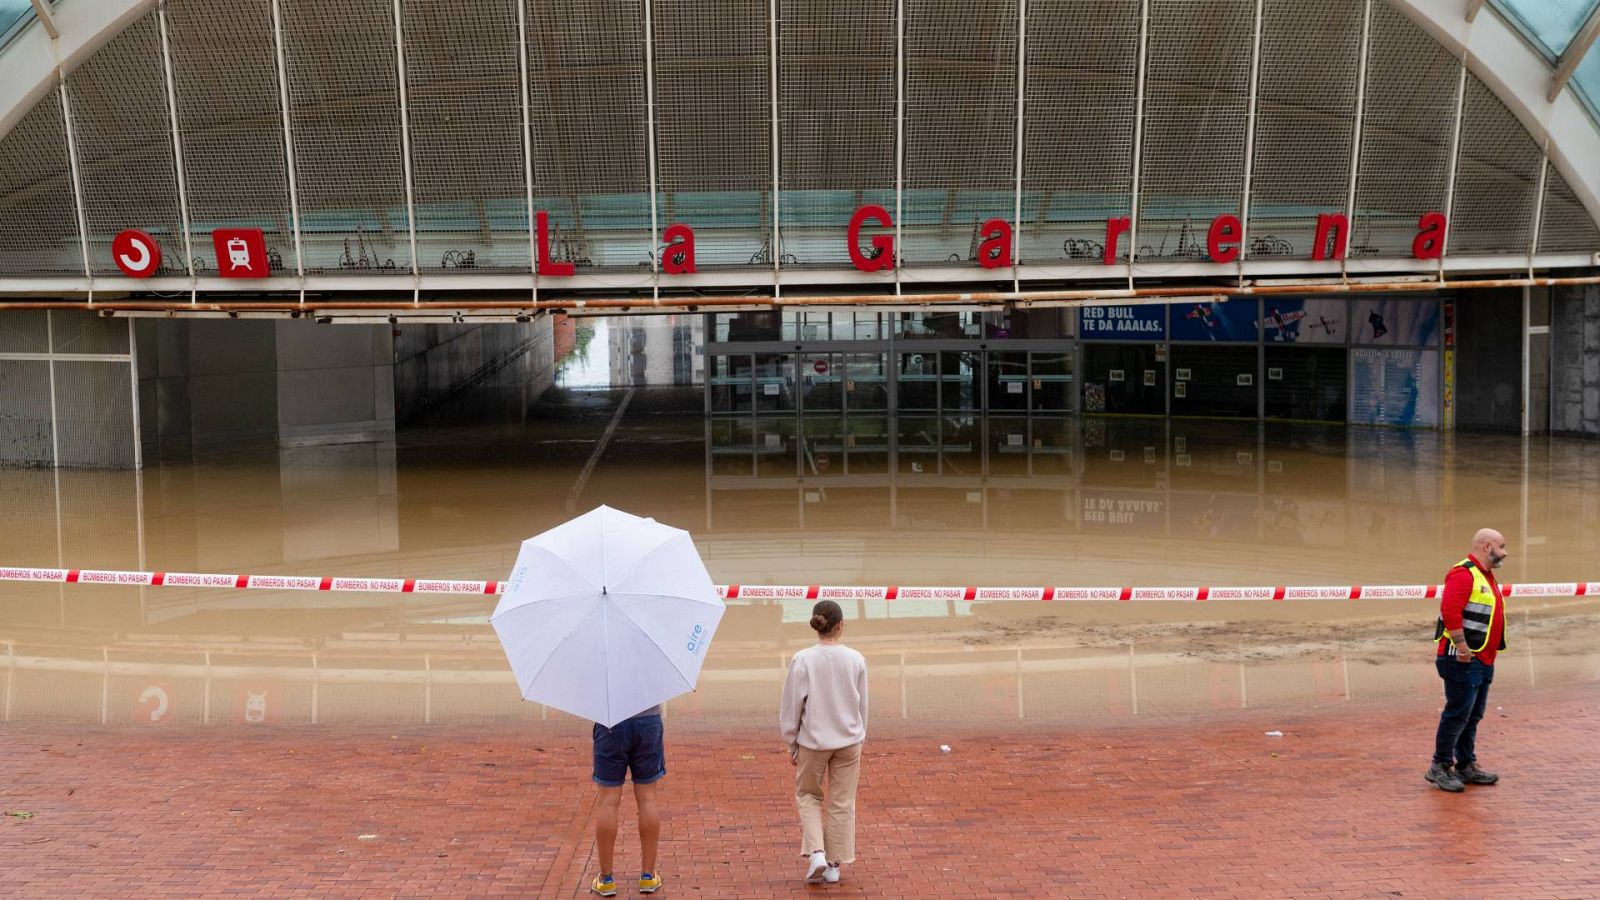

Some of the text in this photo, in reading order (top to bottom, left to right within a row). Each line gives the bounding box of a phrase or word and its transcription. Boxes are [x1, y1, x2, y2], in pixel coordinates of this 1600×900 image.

[536, 203, 1447, 276] La Garena
[1083, 307, 1134, 318] RED BULL
[1083, 320, 1162, 332] TE DA AAALAS.
[43, 571, 63, 579] PASAR
[83, 573, 116, 582] BOMBEROS
[129, 574, 148, 582] PASAR
[168, 575, 201, 584] BOMBEROS
[215, 577, 232, 585] PASAR
[252, 578, 285, 587] BOMBEROS
[297, 579, 316, 587] PASAR
[336, 580, 368, 589] BOMBEROS
[380, 581, 399, 589] PASAR
[419, 582, 451, 591] BOMBEROS
[462, 583, 481, 591] PASAR
[742, 588, 773, 597] BOMBEROS
[785, 588, 803, 596] PASAR
[822, 588, 853, 597] BOMBEROS
[865, 589, 883, 597] PASAR
[901, 589, 932, 598] BOMBEROS
[943, 589, 961, 597] PASAR
[980, 589, 1010, 598] BOMBEROS
[1021, 589, 1039, 597] PASAR
[1058, 590, 1088, 599] BOMBEROS
[1100, 589, 1117, 597] PASAR
[1135, 589, 1165, 598] BOMBEROS
[1177, 589, 1194, 597] PASAR
[1212, 589, 1242, 598] BOMBEROS
[1253, 589, 1270, 597] PASAR
[1288, 589, 1319, 598] BOMBEROS
[1330, 589, 1347, 597] PASAR
[1364, 588, 1394, 597] BOMBEROS
[1406, 588, 1423, 596] PASAR
